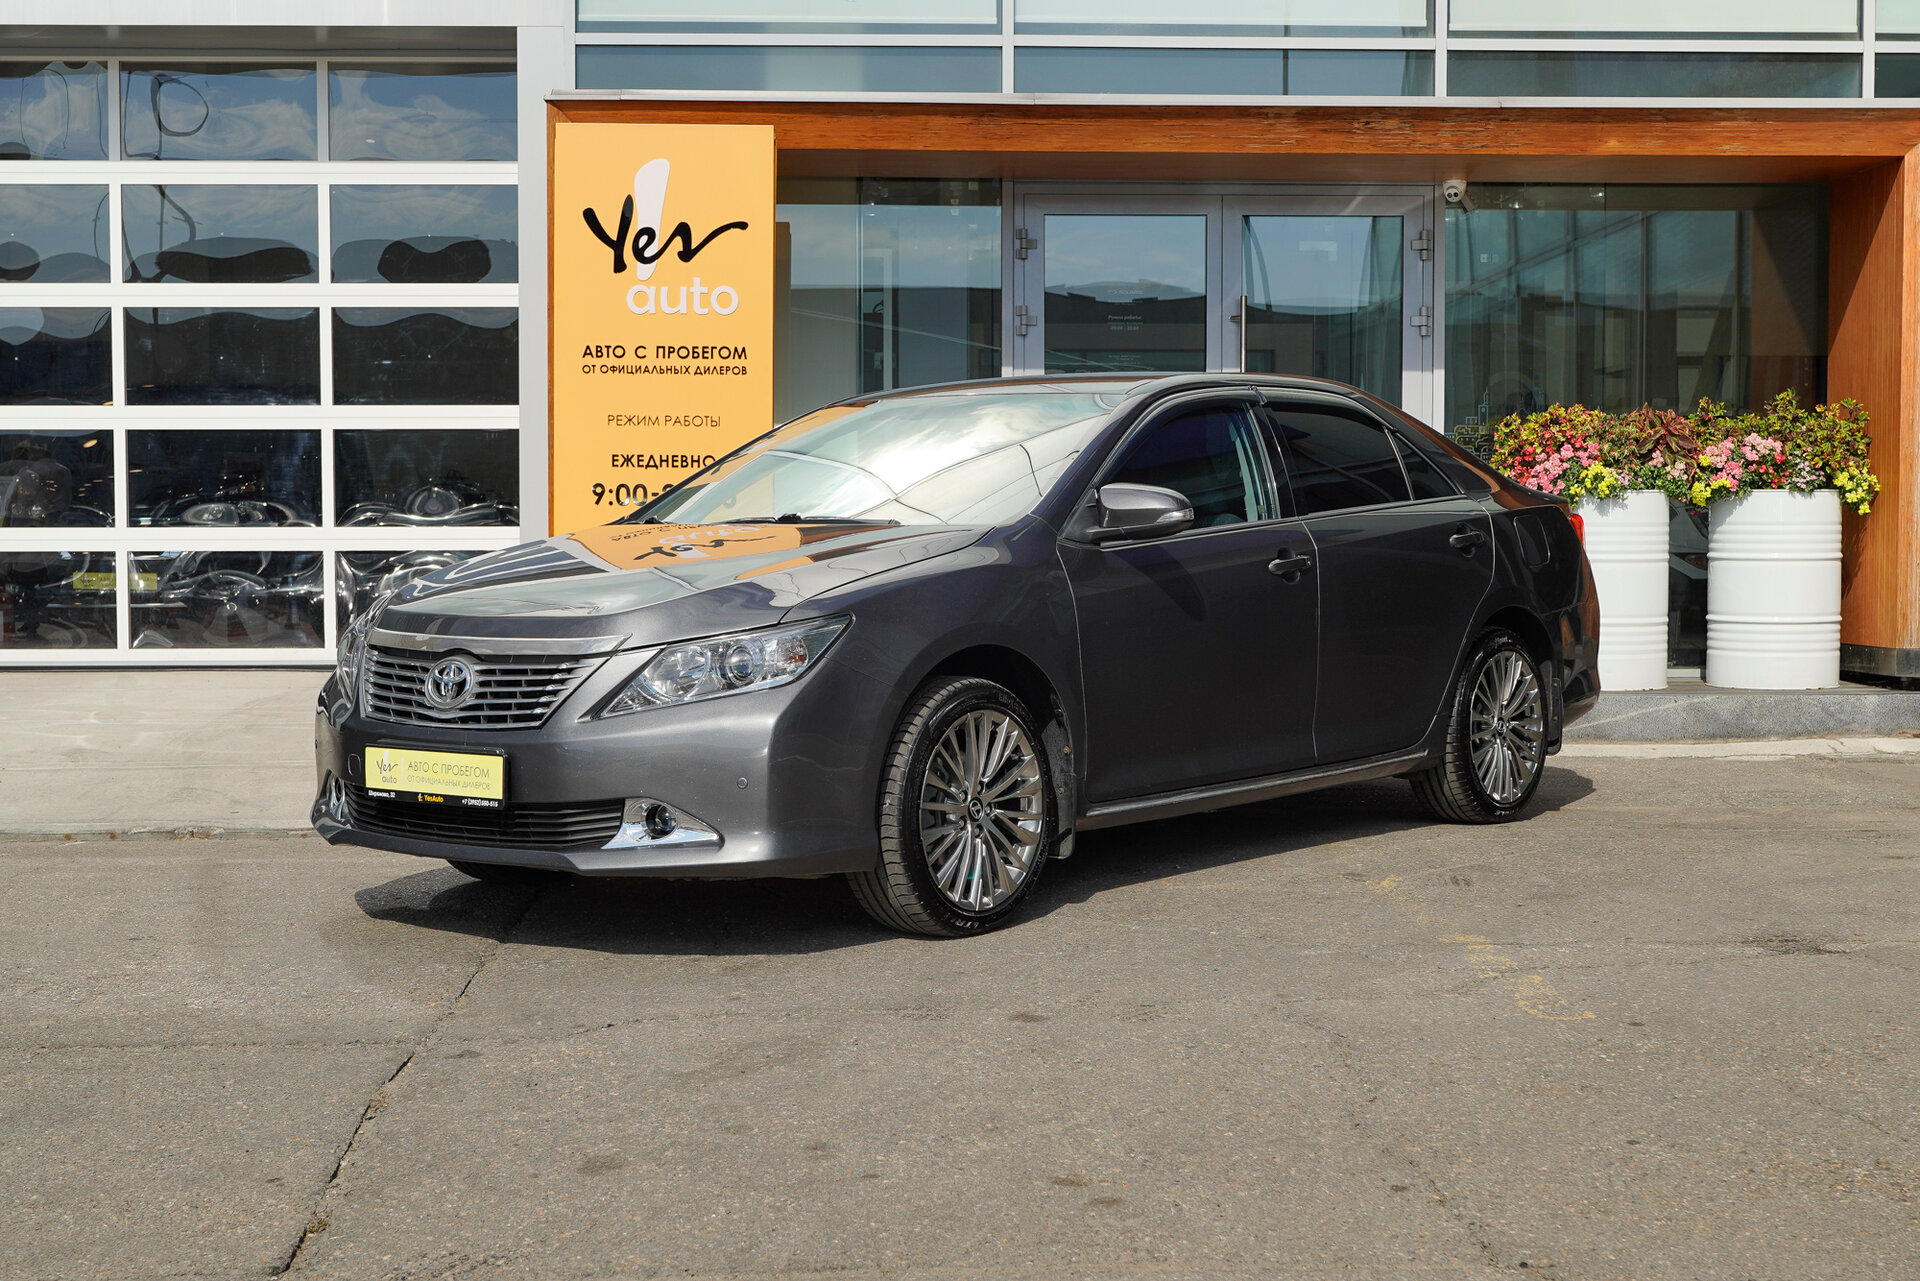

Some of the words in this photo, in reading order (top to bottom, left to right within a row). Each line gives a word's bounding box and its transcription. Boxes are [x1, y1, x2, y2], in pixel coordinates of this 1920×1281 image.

[582, 193, 749, 274] Yes
[626, 277, 739, 315] auto
[582, 345, 626, 359] АВТО
[634, 345, 647, 360] С
[655, 346, 748, 361] ПРОБЕГОМ
[582, 365, 597, 375] ОТ
[599, 365, 691, 376] ОФИЦИАЛЬНЫХ
[693, 366, 748, 377] ДИЛЕРОВ
[607, 414, 660, 427] РЕЖИМ
[664, 415, 721, 428] РАБОТЫ
[611, 454, 716, 470] ЕЖЕДНЕВНО
[407, 761, 430, 773] АВТО
[431, 762, 439, 774] С
[440, 763, 491, 778] ПРОБЕГОМ
[381, 774, 398, 784] auto
[406, 774, 416, 783] ОТ
[423, 794, 445, 803] YesAuto
